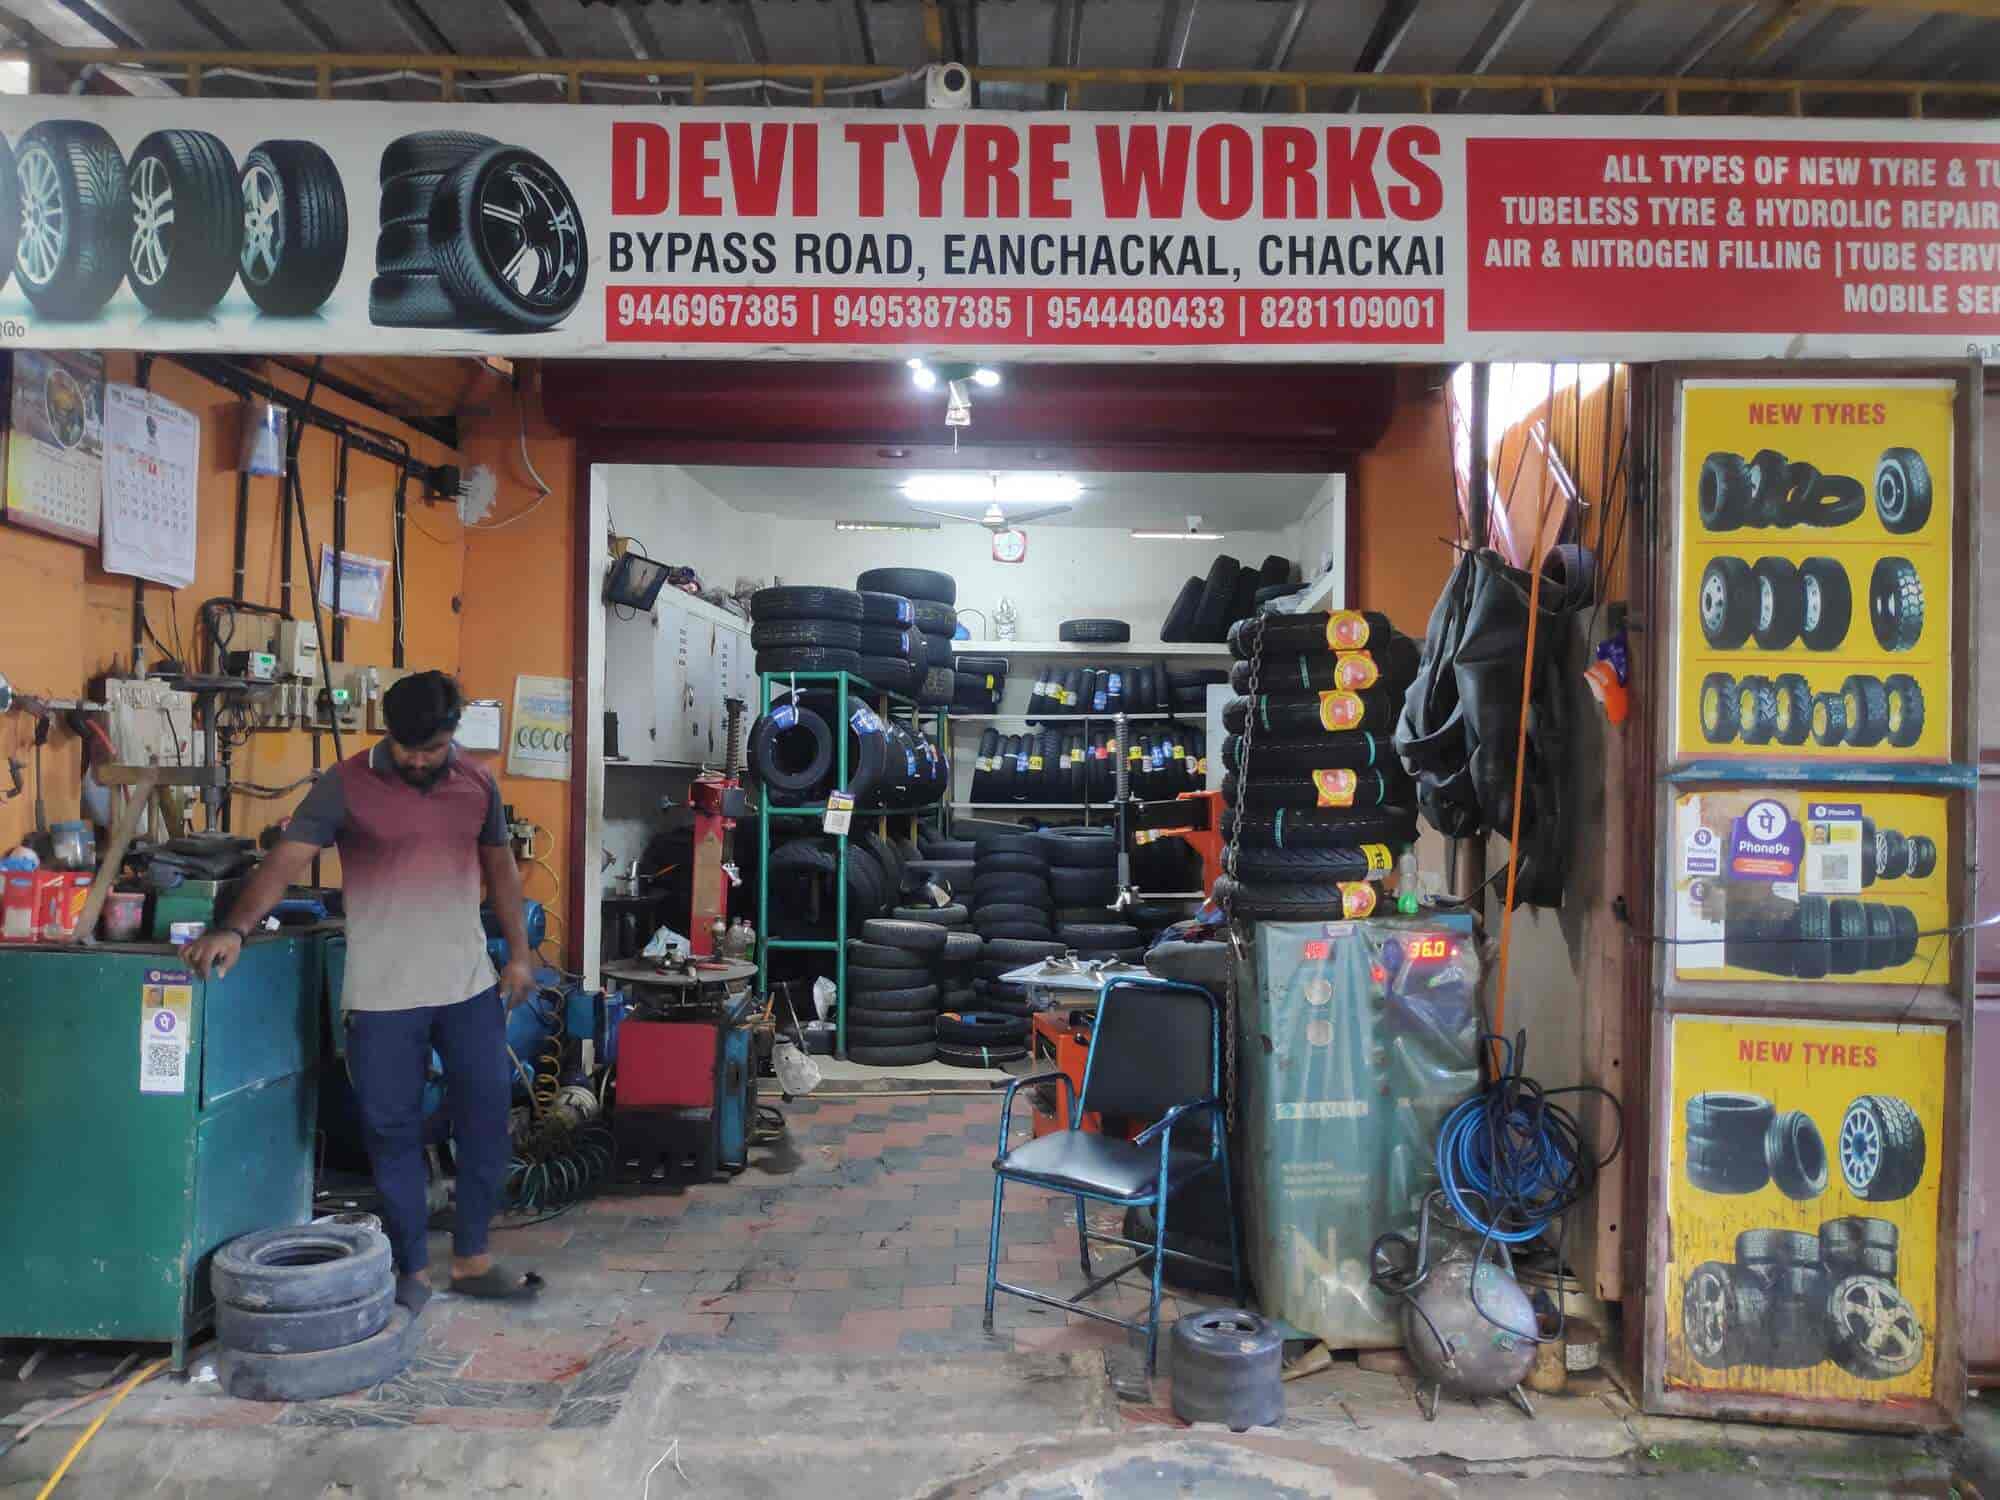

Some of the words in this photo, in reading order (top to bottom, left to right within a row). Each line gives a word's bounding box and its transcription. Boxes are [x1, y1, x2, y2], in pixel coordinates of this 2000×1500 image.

[612, 122, 818, 217] DEVI
[845, 123, 1072, 219] TYRE
[1095, 123, 1444, 221] WORKS
[1603, 155, 1652, 184] ALL
[1660, 155, 1745, 185] TYPES
[1754, 156, 1789, 185] OF
[1799, 157, 1861, 186] NEW
[1869, 157, 1937, 187] TYRE
[1946, 158, 1966, 188] &
[1501, 196, 1639, 226] TUBELESS
[1648, 197, 1716, 227] TYRE
[1725, 197, 1745, 227] &
[1756, 198, 1892, 229] HYDROLIC
[609, 231, 777, 274] BYPASS
[795, 232, 927, 281] ROAD,
[944, 233, 1241, 282] EANCHACKAL,
[1259, 234, 1444, 276] CHACKAI
[1484, 238, 1531, 268] AIR
[1541, 238, 1561, 268] &
[1571, 239, 1709, 269] NITROGEN
[1719, 240, 1821, 270] FILLING
[1846, 241, 1917, 271] TUBE
[1925, 242, 2000, 273] SERV
[617, 293, 798, 327] 9446967385
[833, 294, 1012, 329] 9495387385
[1047, 296, 1225, 329] 9544480433
[1260, 296, 1434, 329] 8281109001
[1844, 283, 1949, 314] MOBILE
[1748, 402, 1803, 425] NEW
[1811, 402, 1886, 425] TYRES
[1739, 840, 1791, 856] PhonePe
[1738, 1039, 1793, 1063] NEW
[1802, 1041, 1878, 1068] TYRES
